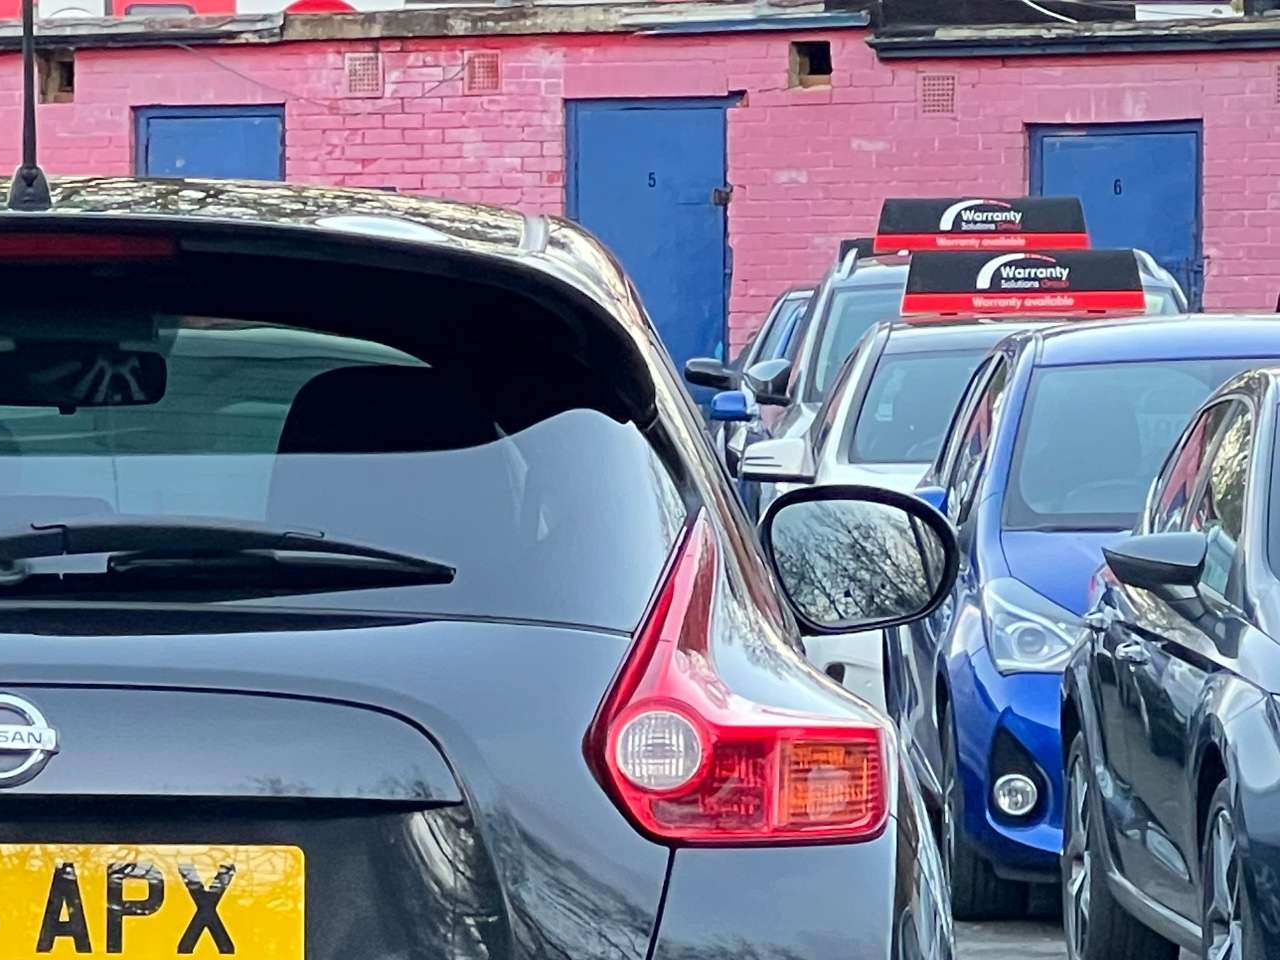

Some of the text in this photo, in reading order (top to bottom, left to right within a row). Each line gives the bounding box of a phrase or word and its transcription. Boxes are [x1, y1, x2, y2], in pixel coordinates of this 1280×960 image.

[648, 171, 656, 188] 5
[1113, 178, 1122, 196] 6
[961, 209, 1022, 224] Warranty
[1000, 265, 1070, 281] Warranty
[1001, 279, 1039, 289] Solutions
[971, 295, 1075, 310] Warranty available
[36, 862, 237, 955] APX
